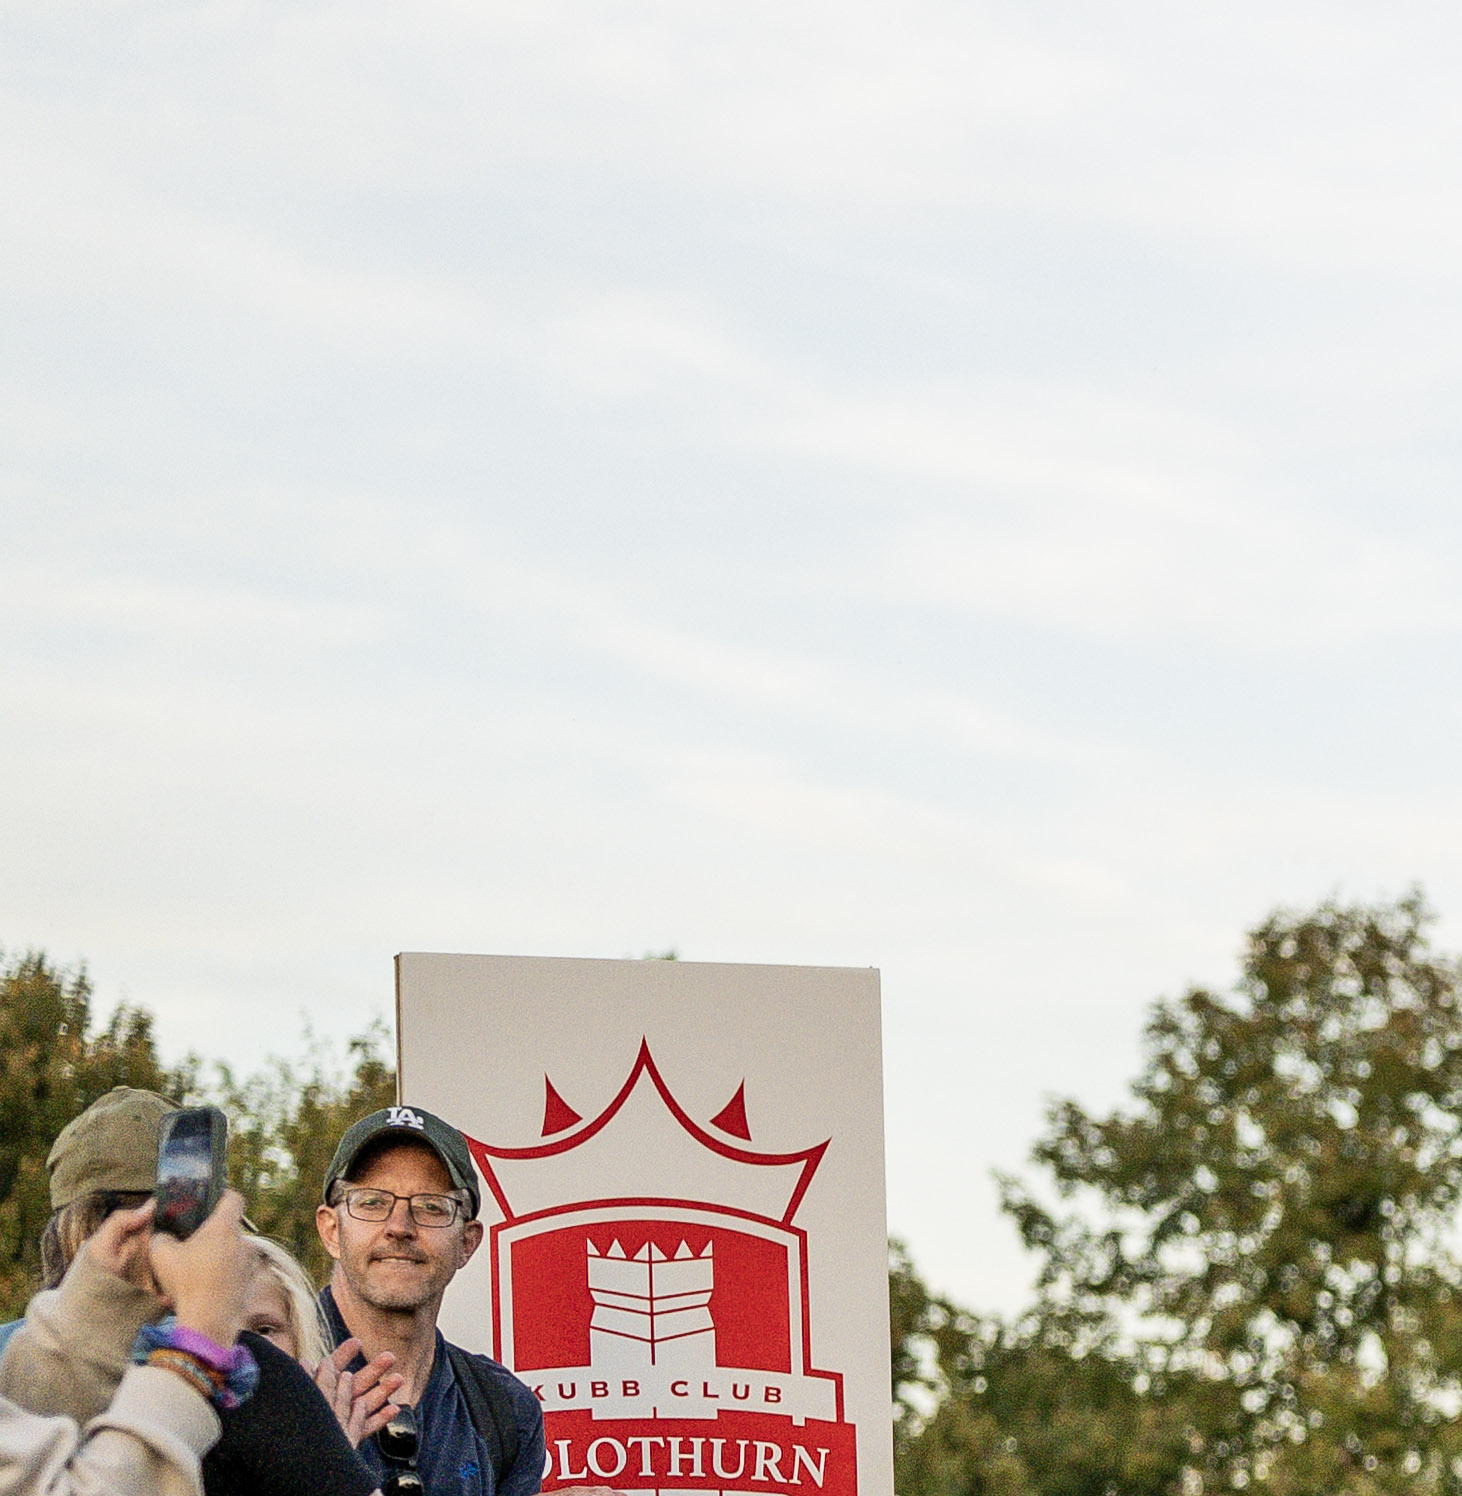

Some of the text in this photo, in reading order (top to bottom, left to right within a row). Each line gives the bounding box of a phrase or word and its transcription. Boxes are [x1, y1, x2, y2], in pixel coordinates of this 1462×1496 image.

[528, 1380, 783, 1405] KUBB CLUB
[542, 1435, 830, 1489] LOTHURN
